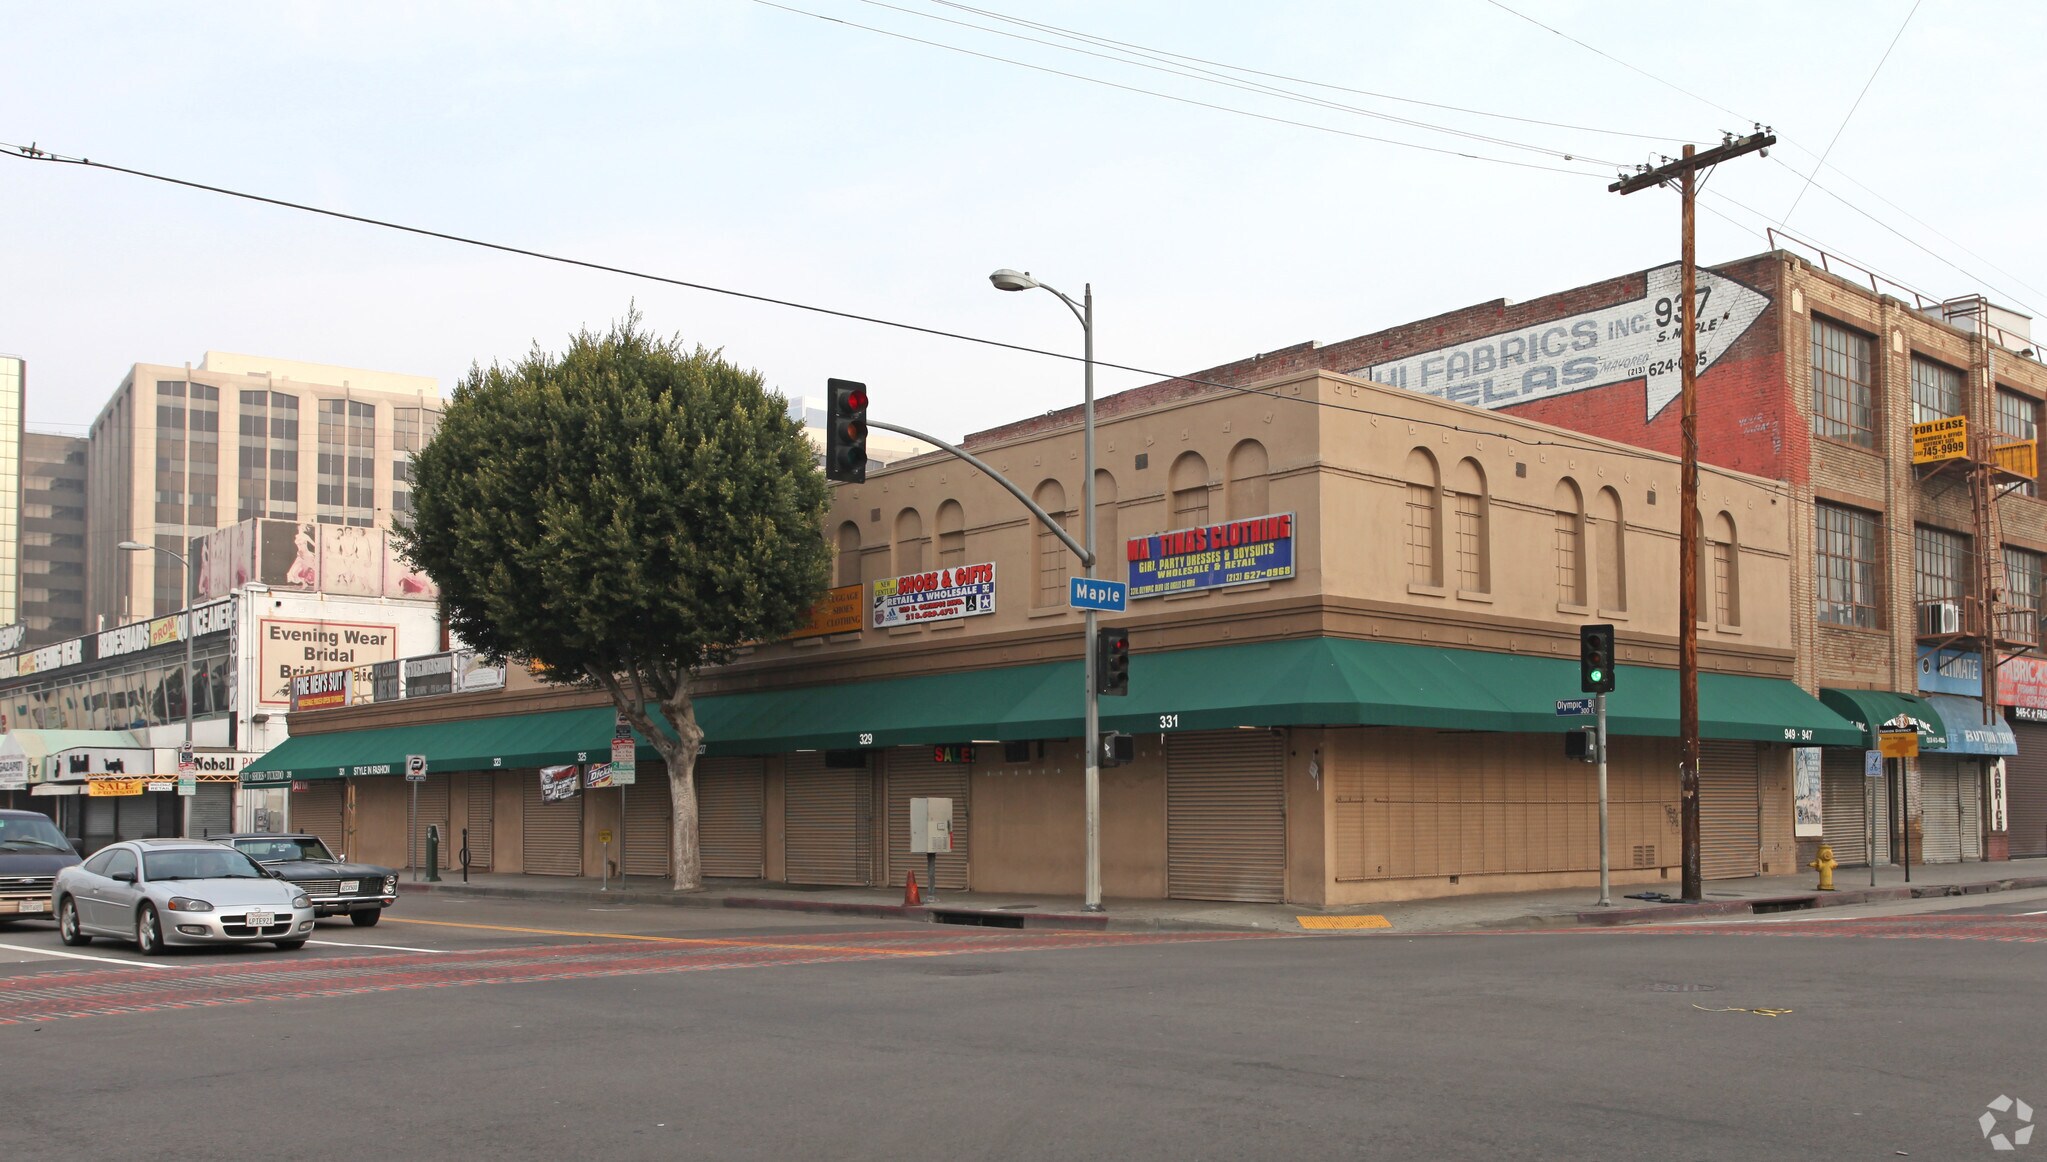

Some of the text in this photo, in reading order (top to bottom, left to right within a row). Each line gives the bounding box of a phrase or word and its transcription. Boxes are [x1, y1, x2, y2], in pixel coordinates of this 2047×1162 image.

[1421, 319, 1598, 387] FABRICS
[1608, 313, 1651, 340] INC.
[1627, 366, 1646, 376] (213)
[1424, 357, 1599, 406] ELAS
[1914, 419, 1964, 435] FOR LEASE
[1923, 441, 1964, 457] 745-9999
[1211, 515, 1291, 549] CLOTHING
[1159, 556, 1184, 570] PARTY
[1186, 551, 1221, 565] DRESSES
[1224, 550, 1230, 560] &
[1233, 543, 1275, 560] BOYSUITS
[1157, 559, 1256, 579] WHOLESALE & RETAIL
[1226, 566, 1291, 582] (213) 627-0968
[897, 563, 993, 595] SHOES & GIFTS
[875, 588, 896, 596] CENTURY
[887, 585, 977, 607] RETAIL & WHOLESALE
[1076, 583, 1120, 604] Maple
[833, 605, 854, 614] SHOES
[826, 616, 860, 627] CLOTHING
[152, 617, 176, 644] PROM
[270, 626, 388, 646] Evening Wear
[98, 622, 150, 659] BRIDESMAIDS
[304, 647, 355, 663] Bridal
[1940, 655, 1978, 680] ULTIMATE
[297, 675, 310, 696] FINE
[328, 670, 344, 692] SUIT
[1557, 700, 1582, 711] Olympic
[2015, 707, 2030, 718] 945-C
[1159, 715, 1178, 729] 331
[859, 733, 873, 745] 329
[1785, 729, 1813, 741] 949 947
[195, 756, 235, 771] Nobell
[577, 752, 587, 762] 325
[353, 766, 367, 775] STYLE
[373, 764, 391, 774] FASHION
[294, 780, 309, 790] ATM
